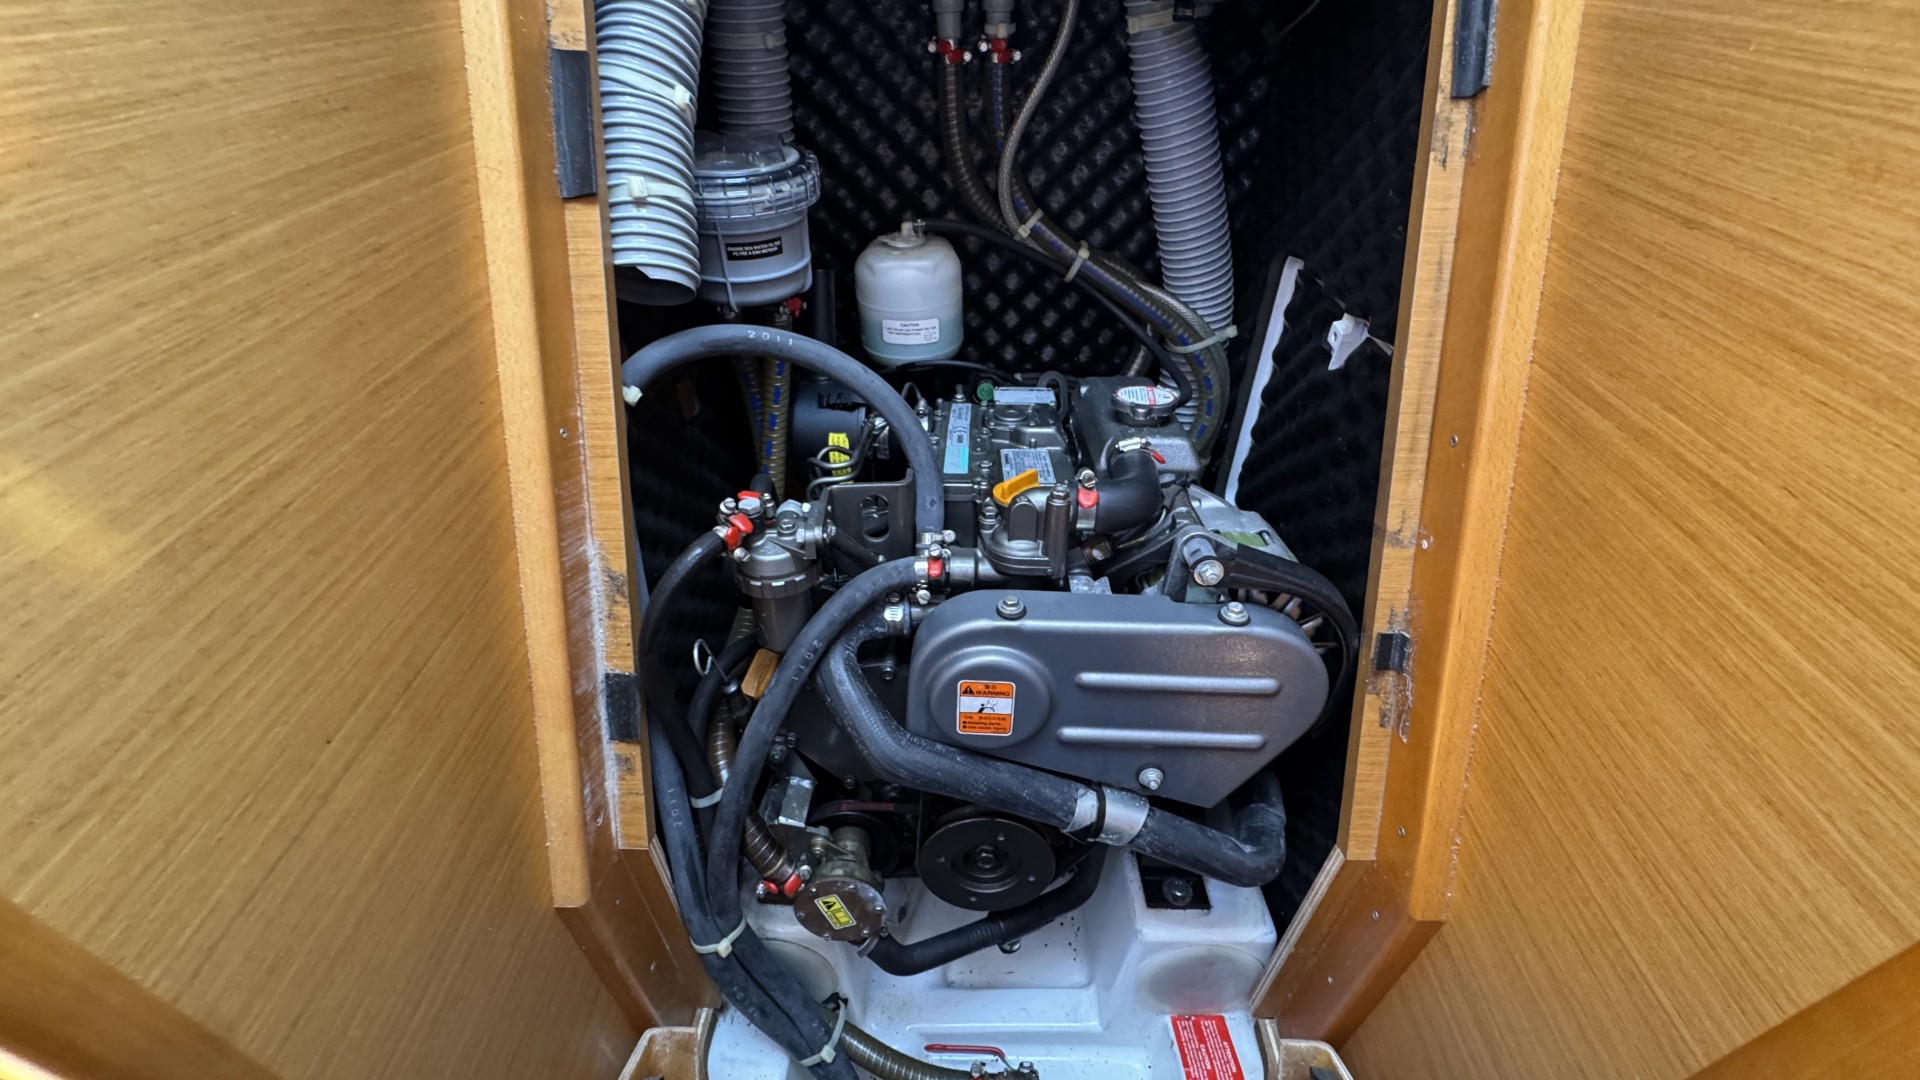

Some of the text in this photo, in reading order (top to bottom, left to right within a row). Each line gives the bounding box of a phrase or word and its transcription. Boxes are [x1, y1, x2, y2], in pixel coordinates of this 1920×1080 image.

[747, 329, 793, 346] 2011
[791, 639, 822, 681] 2011
[667, 787, 683, 828] 2011
[1199, 1043, 1212, 1070] CAUTION
